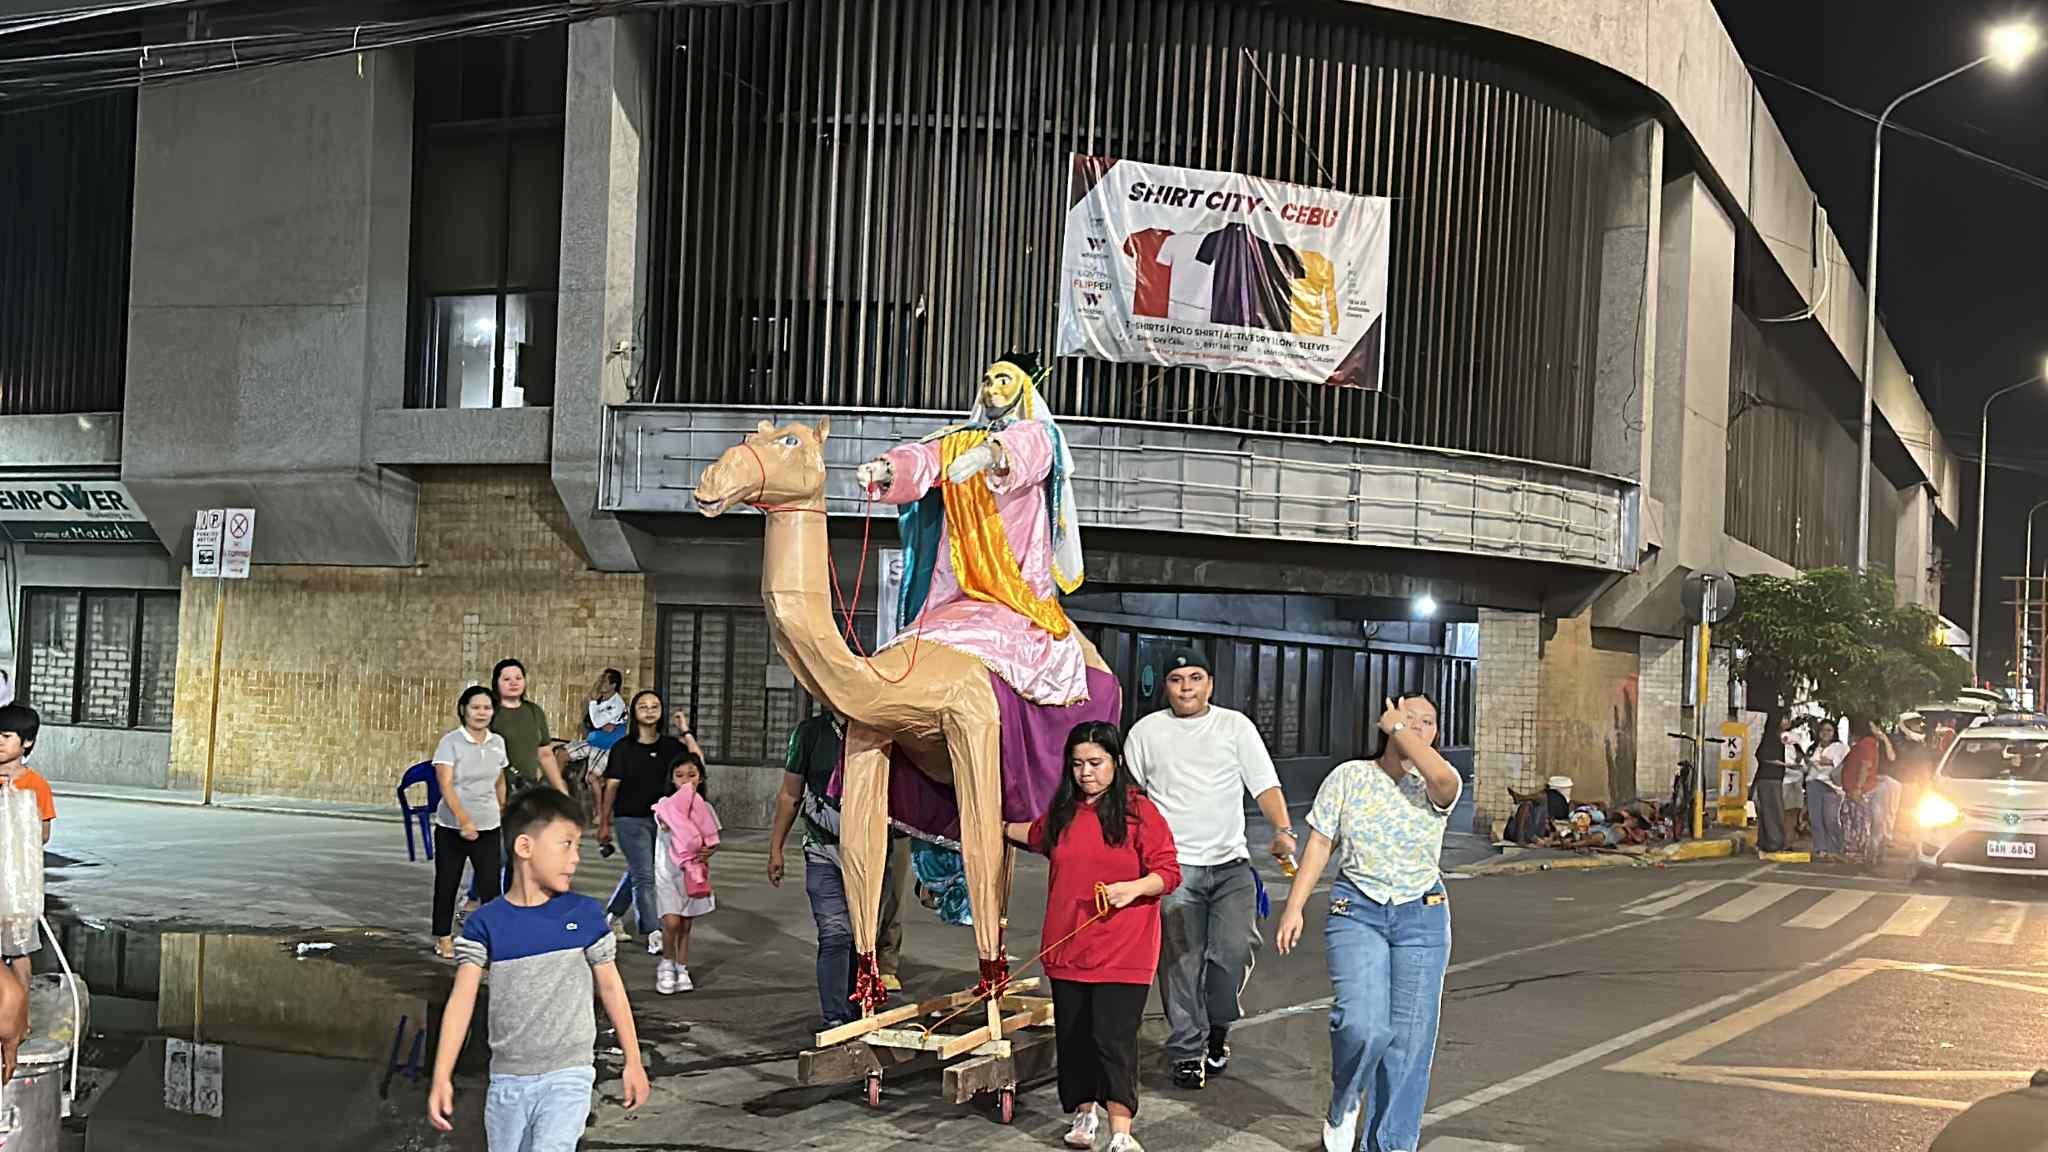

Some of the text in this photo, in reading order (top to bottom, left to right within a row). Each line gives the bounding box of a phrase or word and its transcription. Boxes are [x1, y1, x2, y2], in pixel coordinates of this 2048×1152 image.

[1128, 181, 1205, 209] SHIRT
[1205, 189, 1266, 215] CITY
[1280, 201, 1339, 229] CEBU
[1170, 325, 1193, 336] POLO
[1194, 327, 1219, 337] SHIRT
[1298, 340, 1331, 352] SLEEVES
[0, 483, 130, 511] EMPOWER
